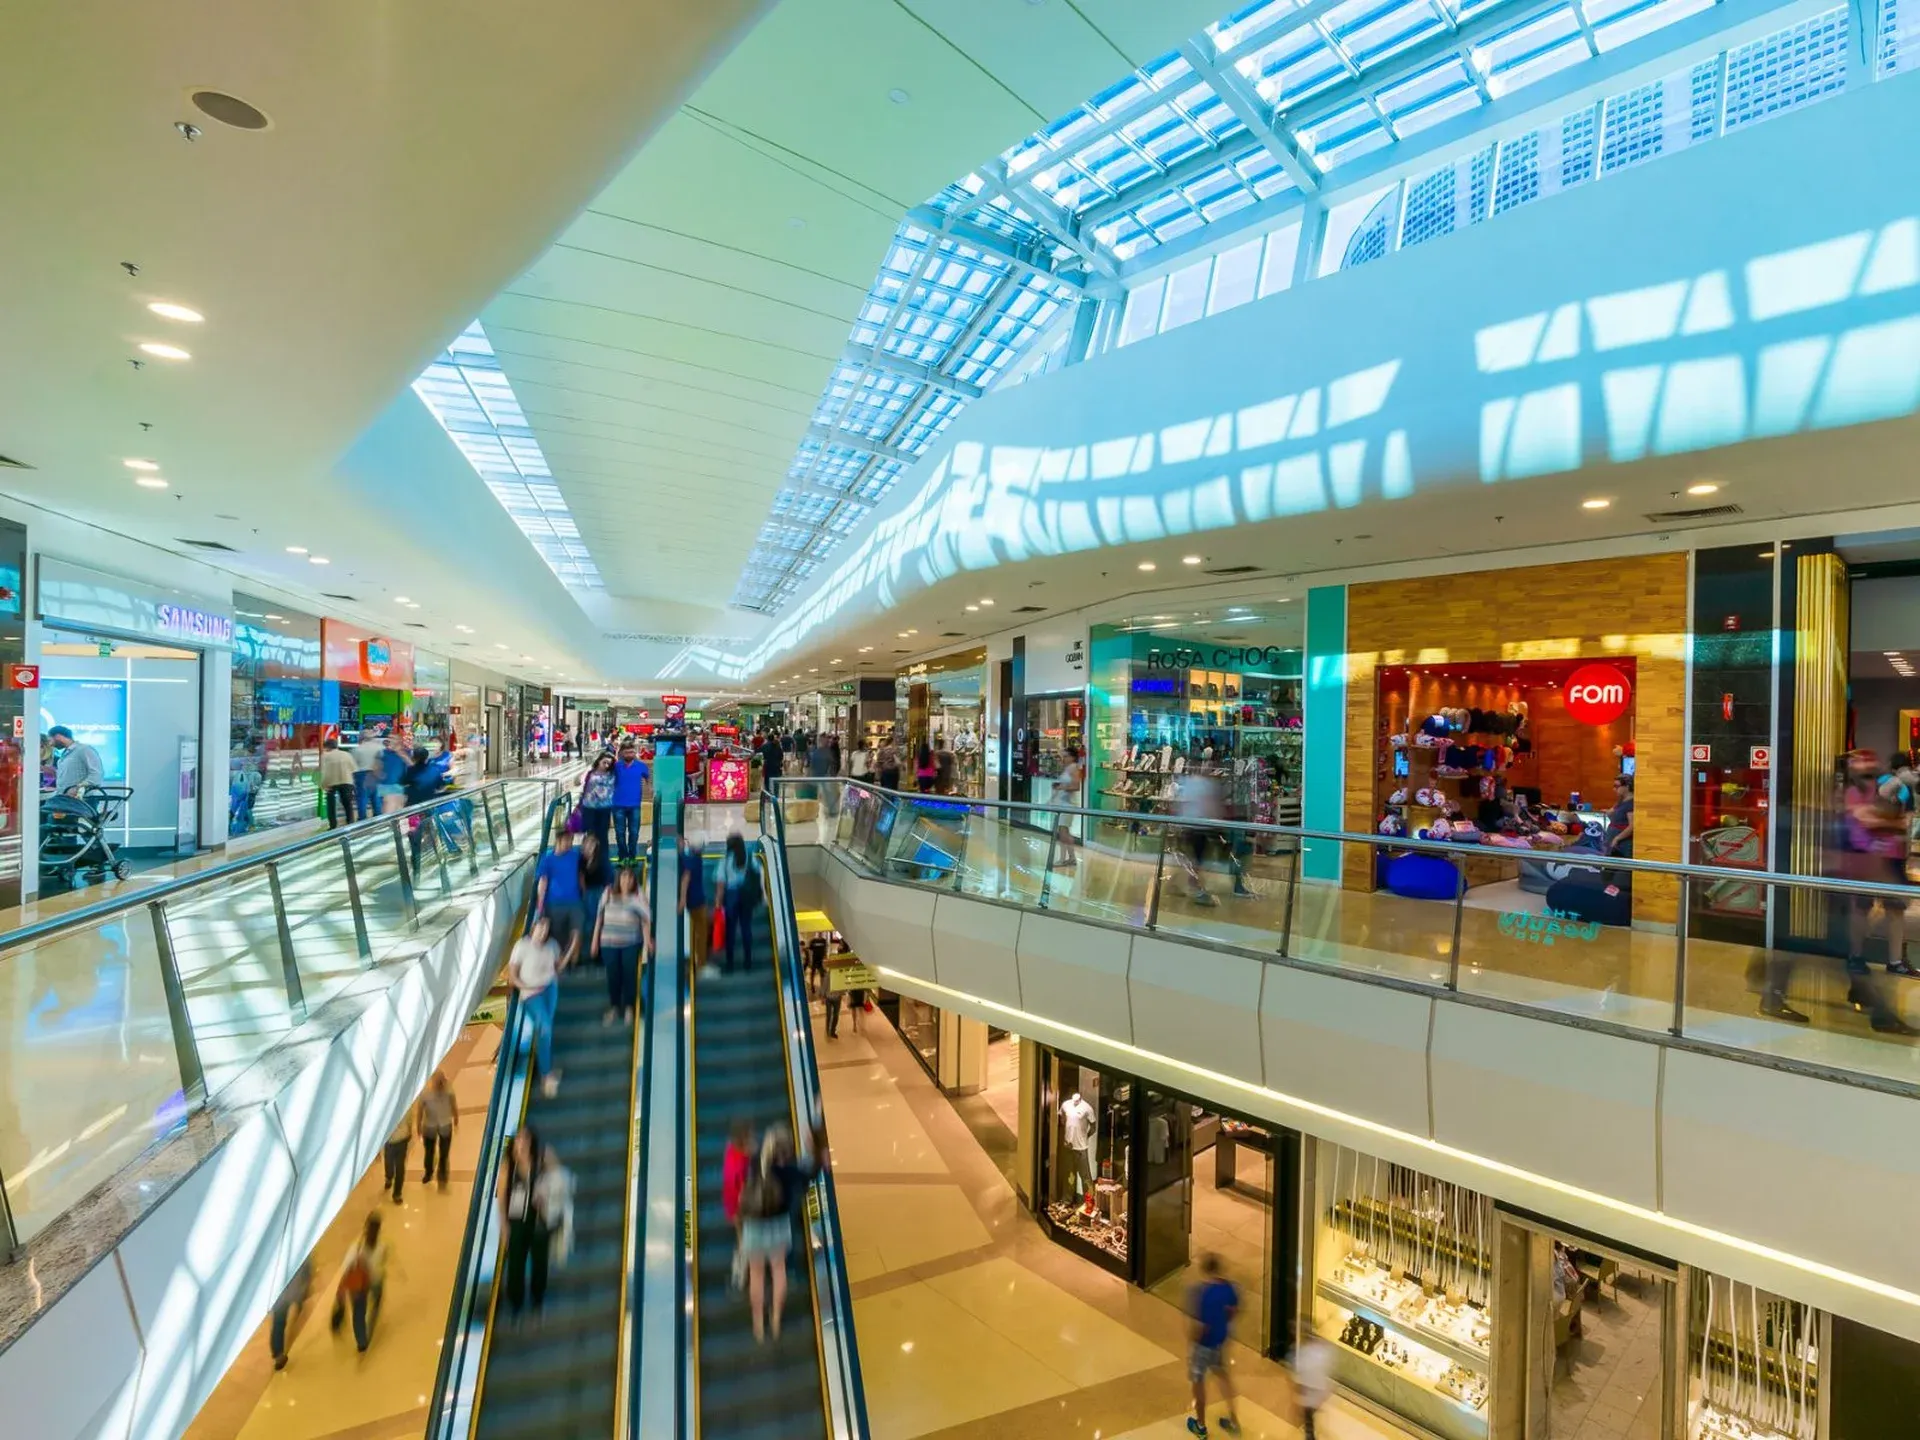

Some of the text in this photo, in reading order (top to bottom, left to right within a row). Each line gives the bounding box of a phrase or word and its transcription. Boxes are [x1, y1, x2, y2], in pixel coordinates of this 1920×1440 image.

[157, 604, 232, 642] SAMSUNG
[1147, 651, 1205, 670] ROSA
[1570, 685, 1623, 704] FOM
